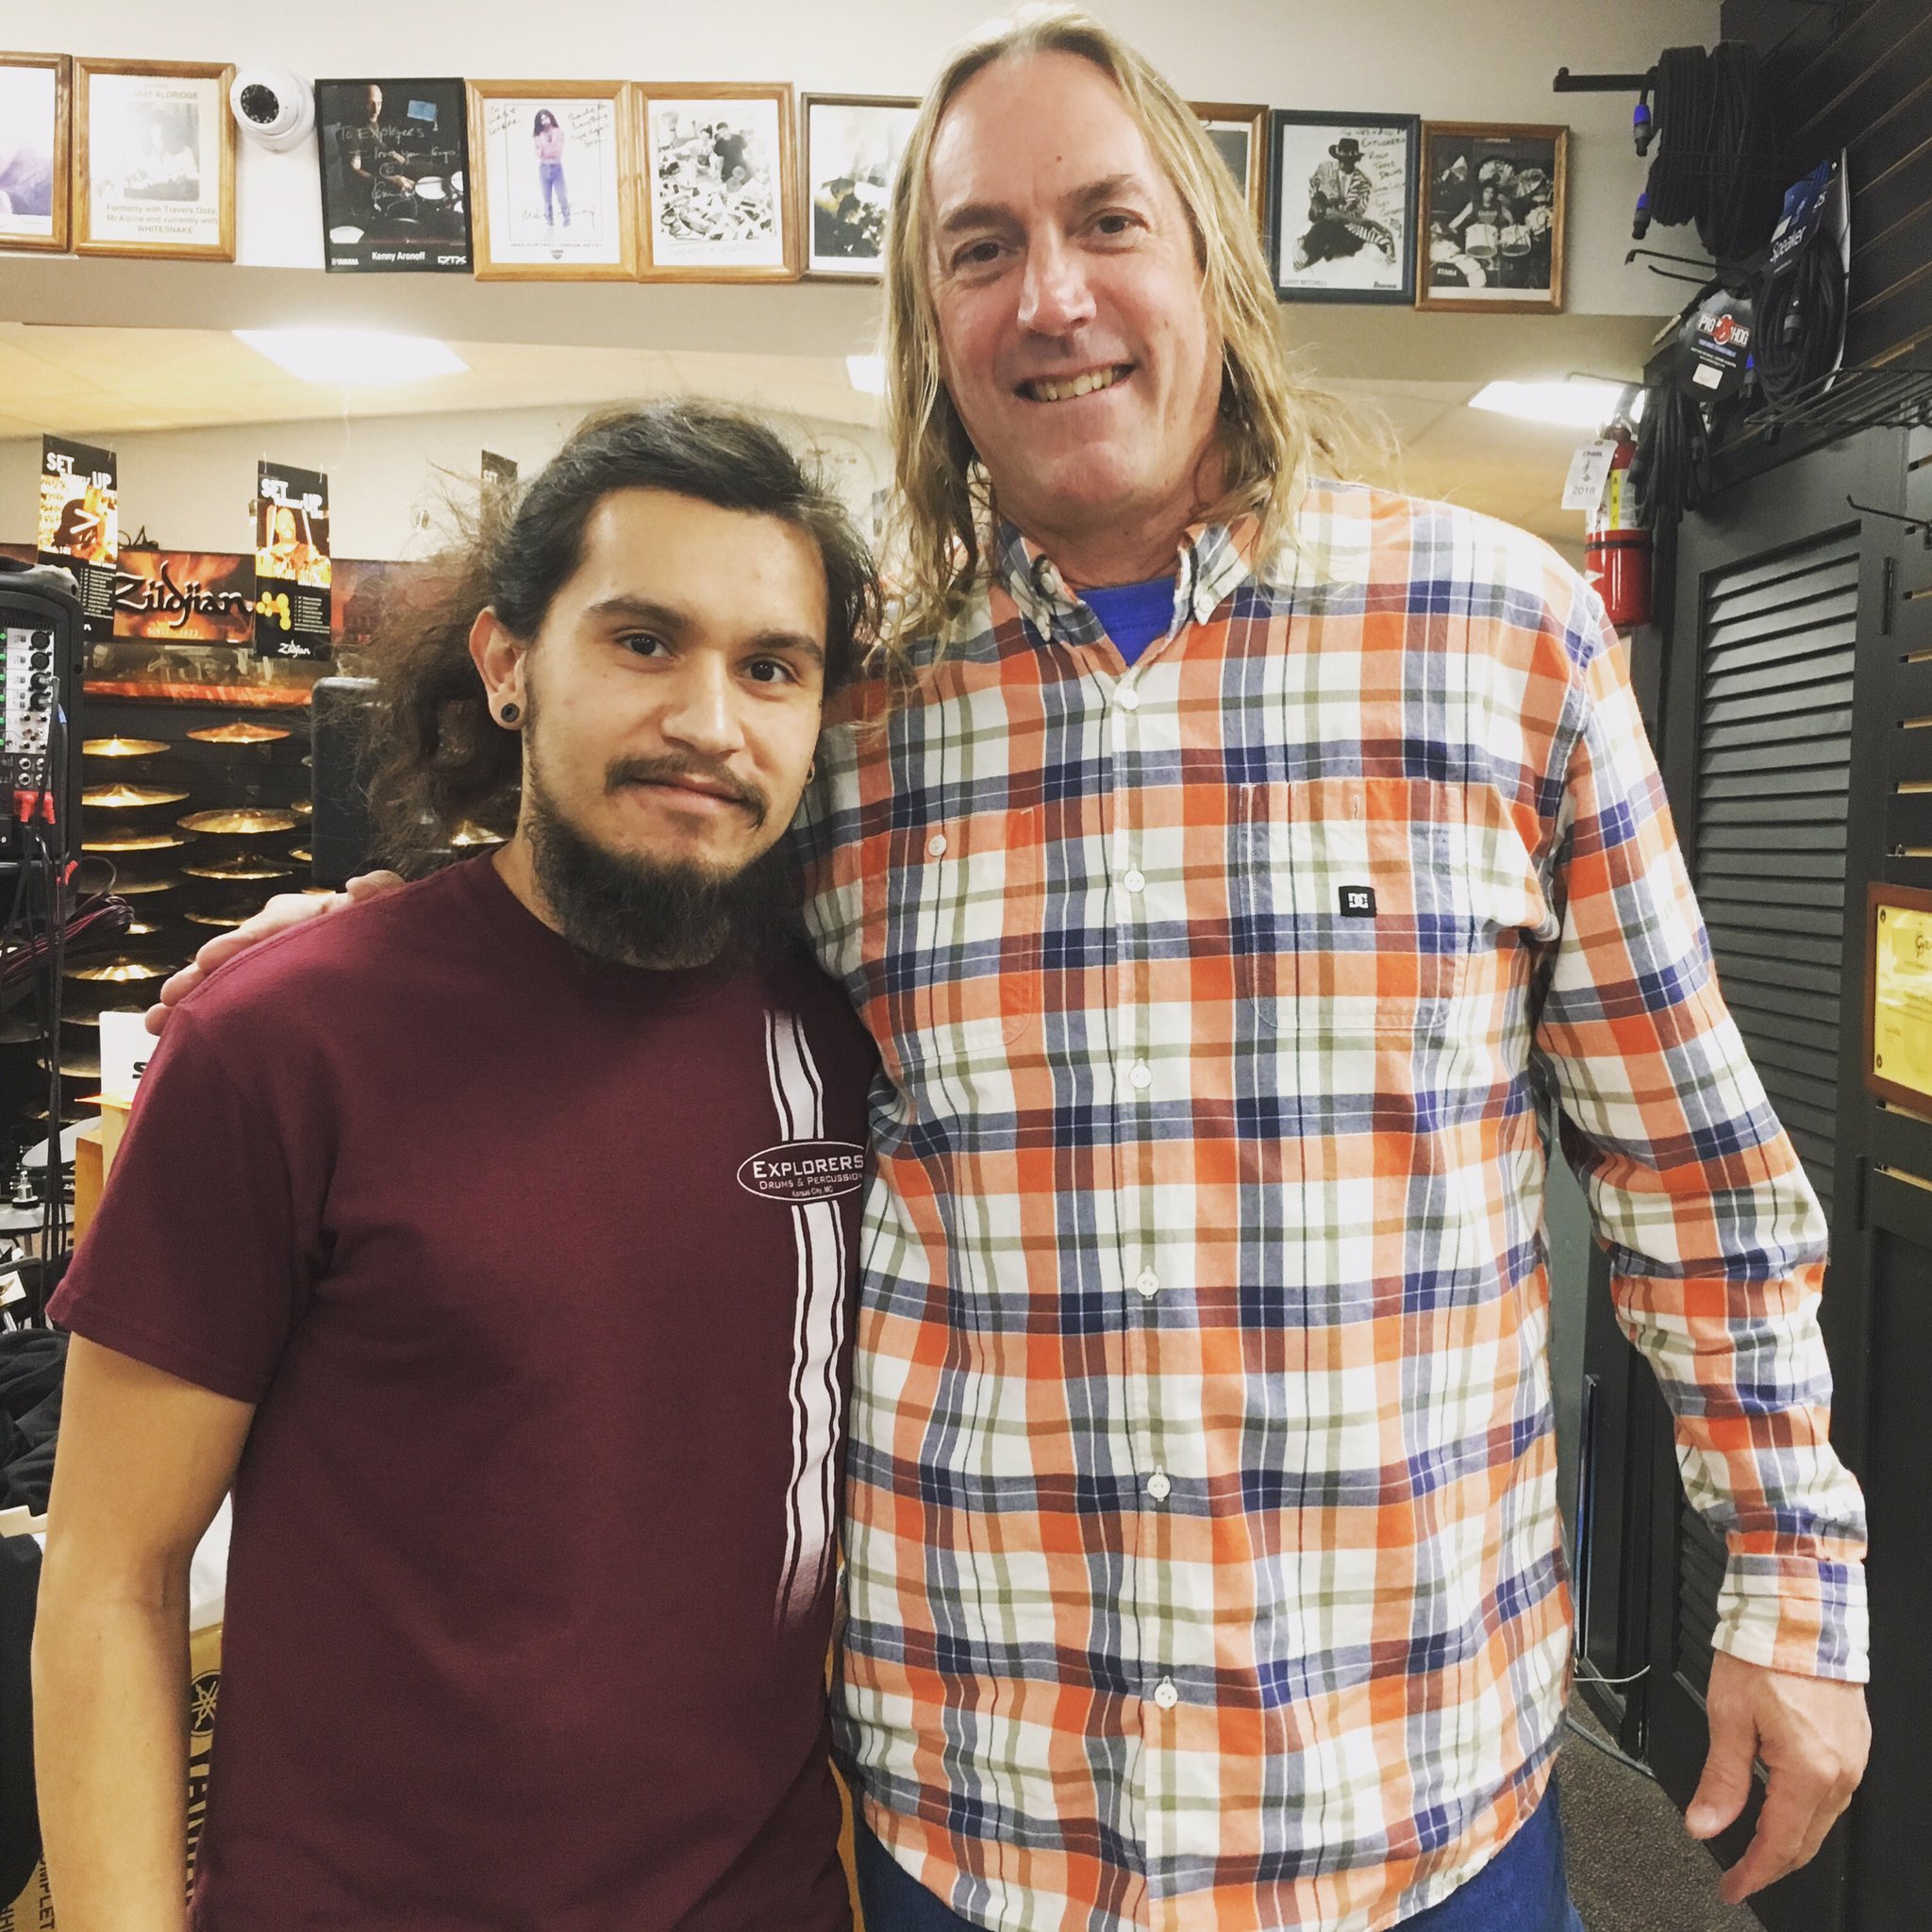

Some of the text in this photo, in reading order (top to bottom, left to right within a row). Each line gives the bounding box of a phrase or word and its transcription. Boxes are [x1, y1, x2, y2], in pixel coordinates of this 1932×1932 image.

[156, 91, 199, 100] ALDRIDGE
[107, 204, 143, 213] Formerly
[145, 205, 162, 213] with
[107, 214, 144, 224] McAlpine
[163, 216, 199, 225] currently
[201, 217, 219, 225] with
[138, 225, 193, 235] WHITESNAKE
[1770, 226, 1807, 263] Speaker
[372, 251, 425, 262] Kenny Aronoff
[1699, 315, 1750, 345] PIG HOG
[46, 452, 75, 475] SET
[92, 471, 112, 491] UP
[261, 478, 289, 500] SET
[303, 493, 323, 515] UP
[115, 559, 253, 628] Zildjian
[277, 639, 310, 658] Zildjian
[753, 1155, 864, 1178] EXPLORERS
[759, 1179, 794, 1190] DRUMS
[797, 1177, 804, 1187] &
